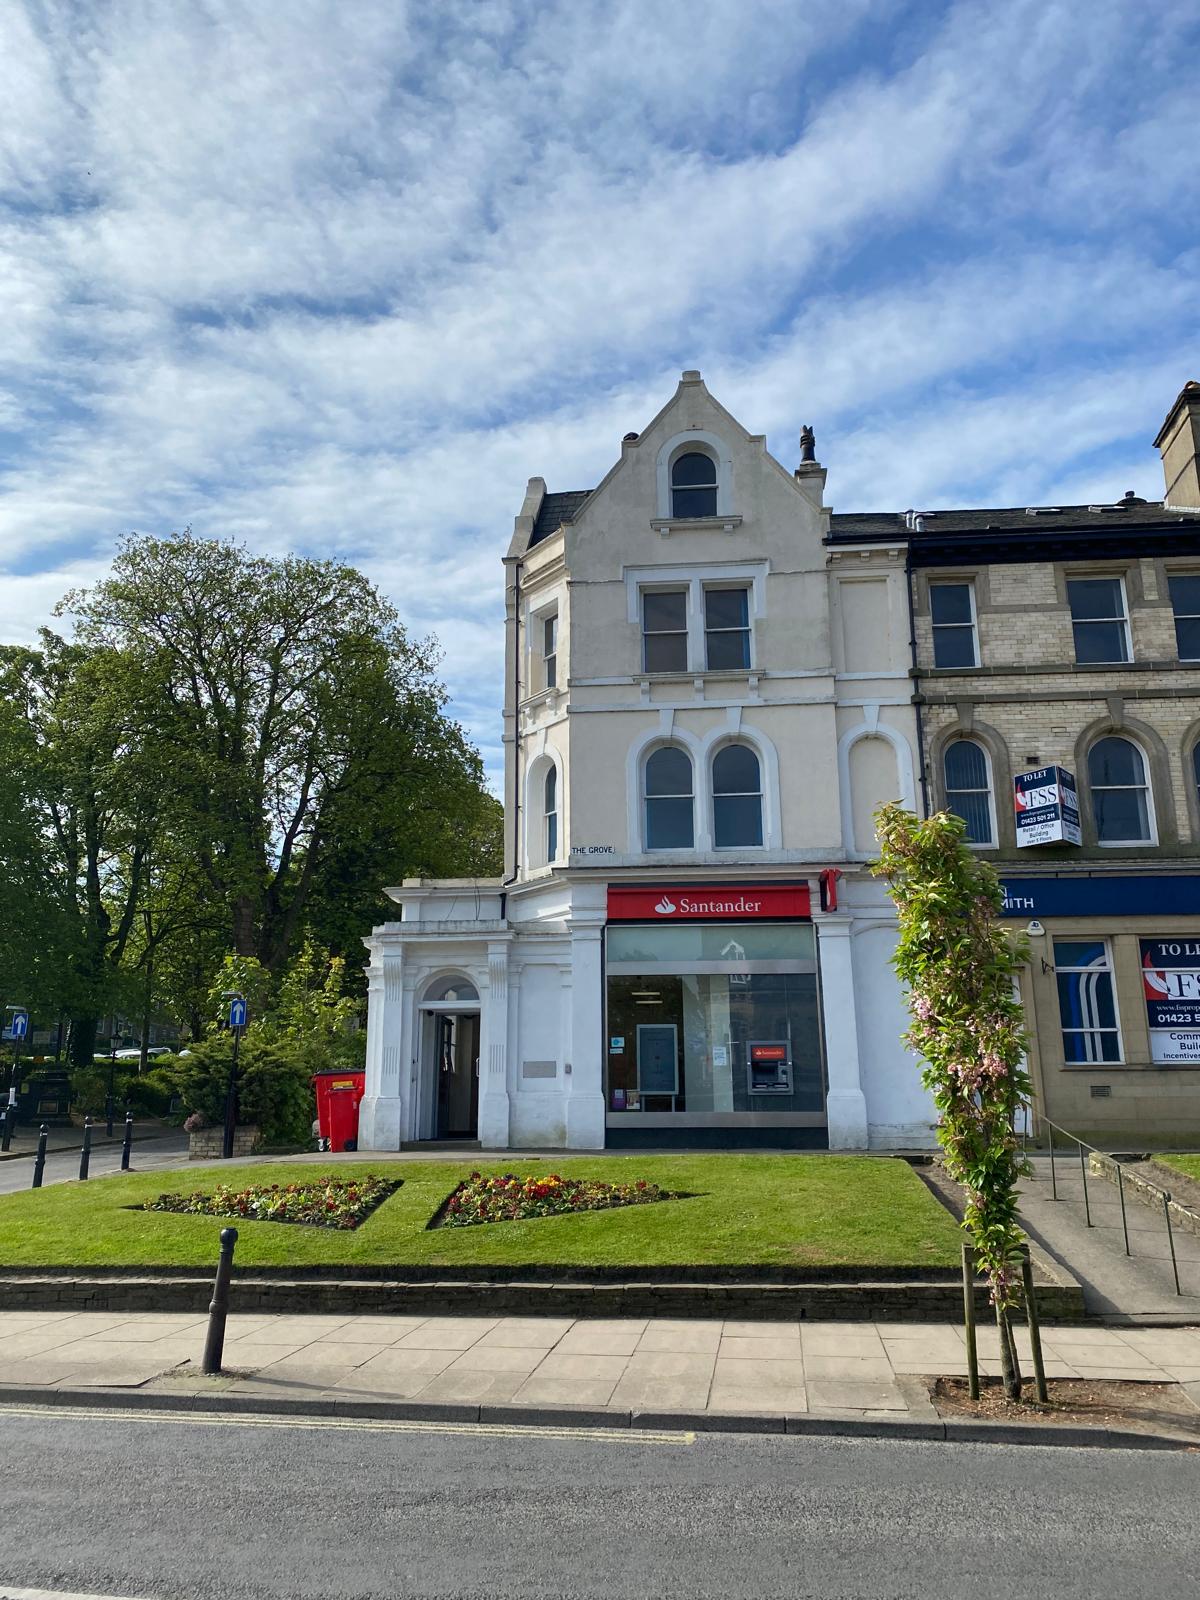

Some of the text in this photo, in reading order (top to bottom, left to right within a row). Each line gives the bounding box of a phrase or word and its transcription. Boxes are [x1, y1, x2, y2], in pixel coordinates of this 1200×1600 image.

[1034, 770, 1047, 780] LET
[1027, 787, 1057, 807] FSS
[588, 846, 612, 854] GROVE
[680, 896, 761, 913] Santander
[1158, 944, 1181, 956] TO
[1171, 973, 1200, 997] F
[1158, 1014, 1192, 1022] 01423
